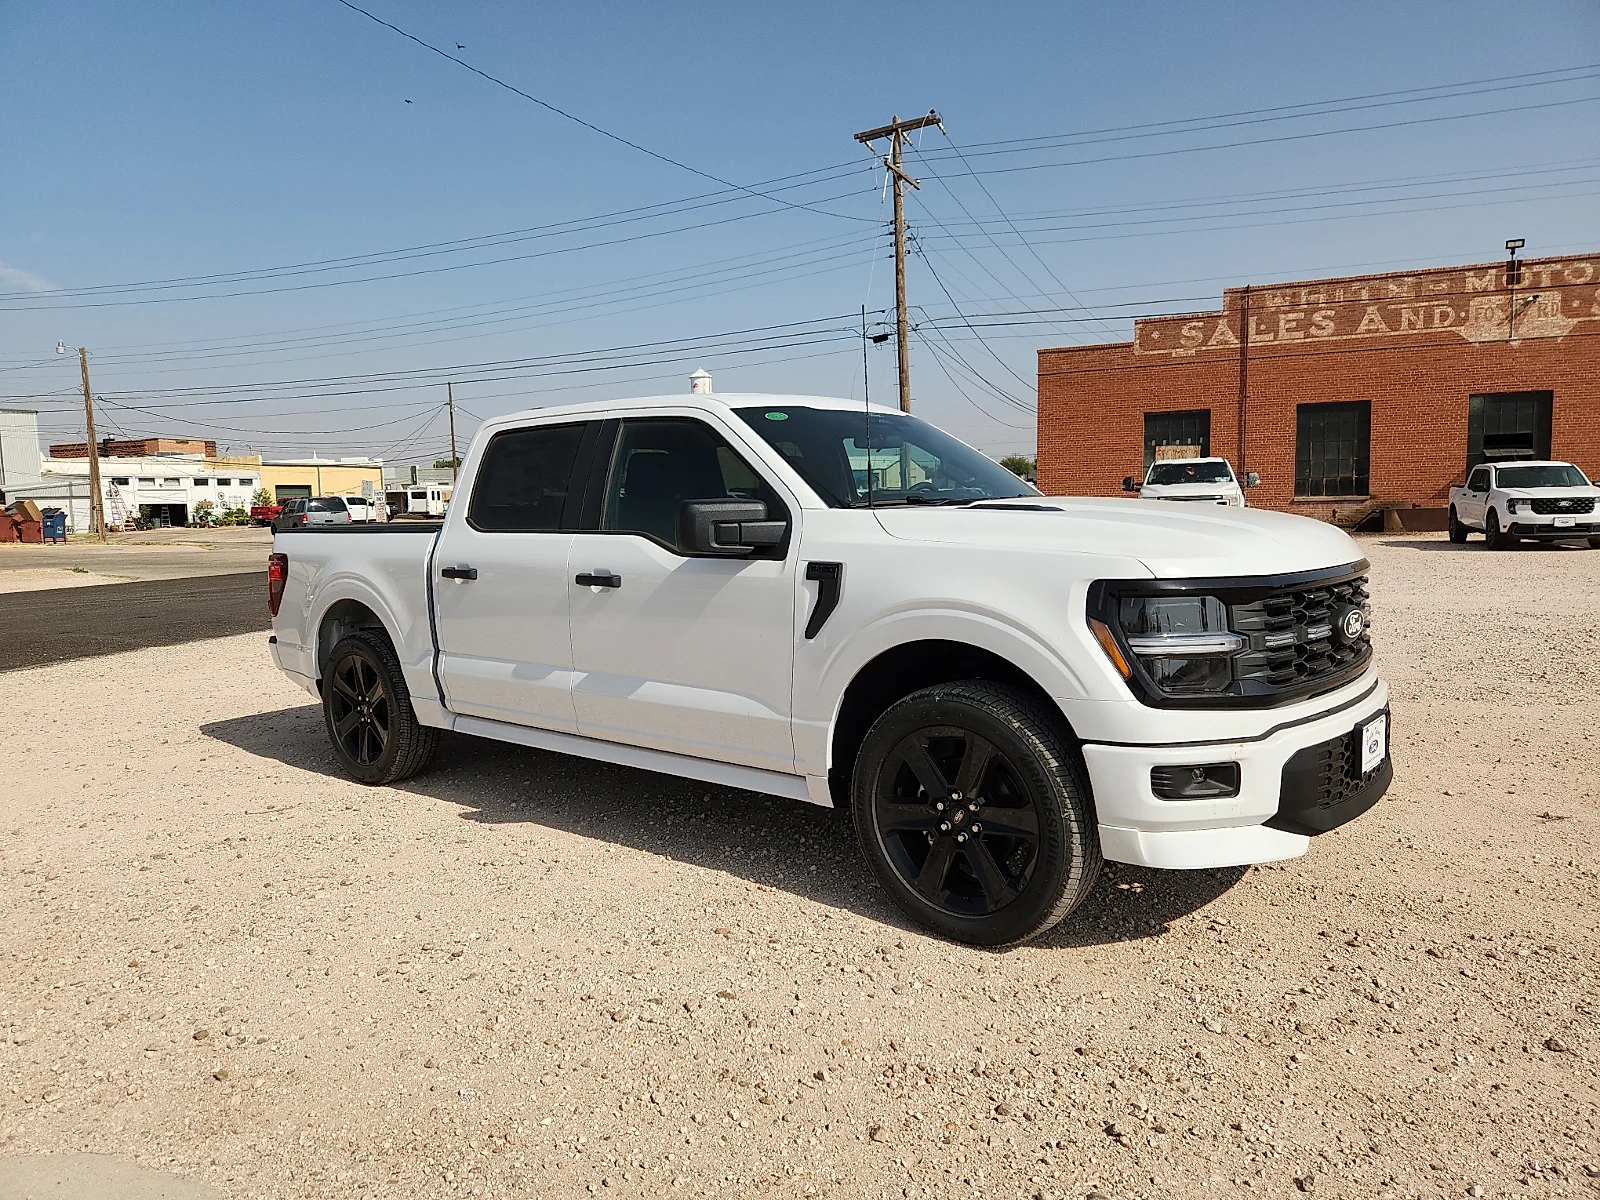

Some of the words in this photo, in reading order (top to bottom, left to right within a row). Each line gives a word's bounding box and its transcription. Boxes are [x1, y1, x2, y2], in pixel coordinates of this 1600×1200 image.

[1465, 262, 1600, 293] MOTO
[1179, 310, 1336, 347] SALES
[1355, 306, 1456, 333] AND
